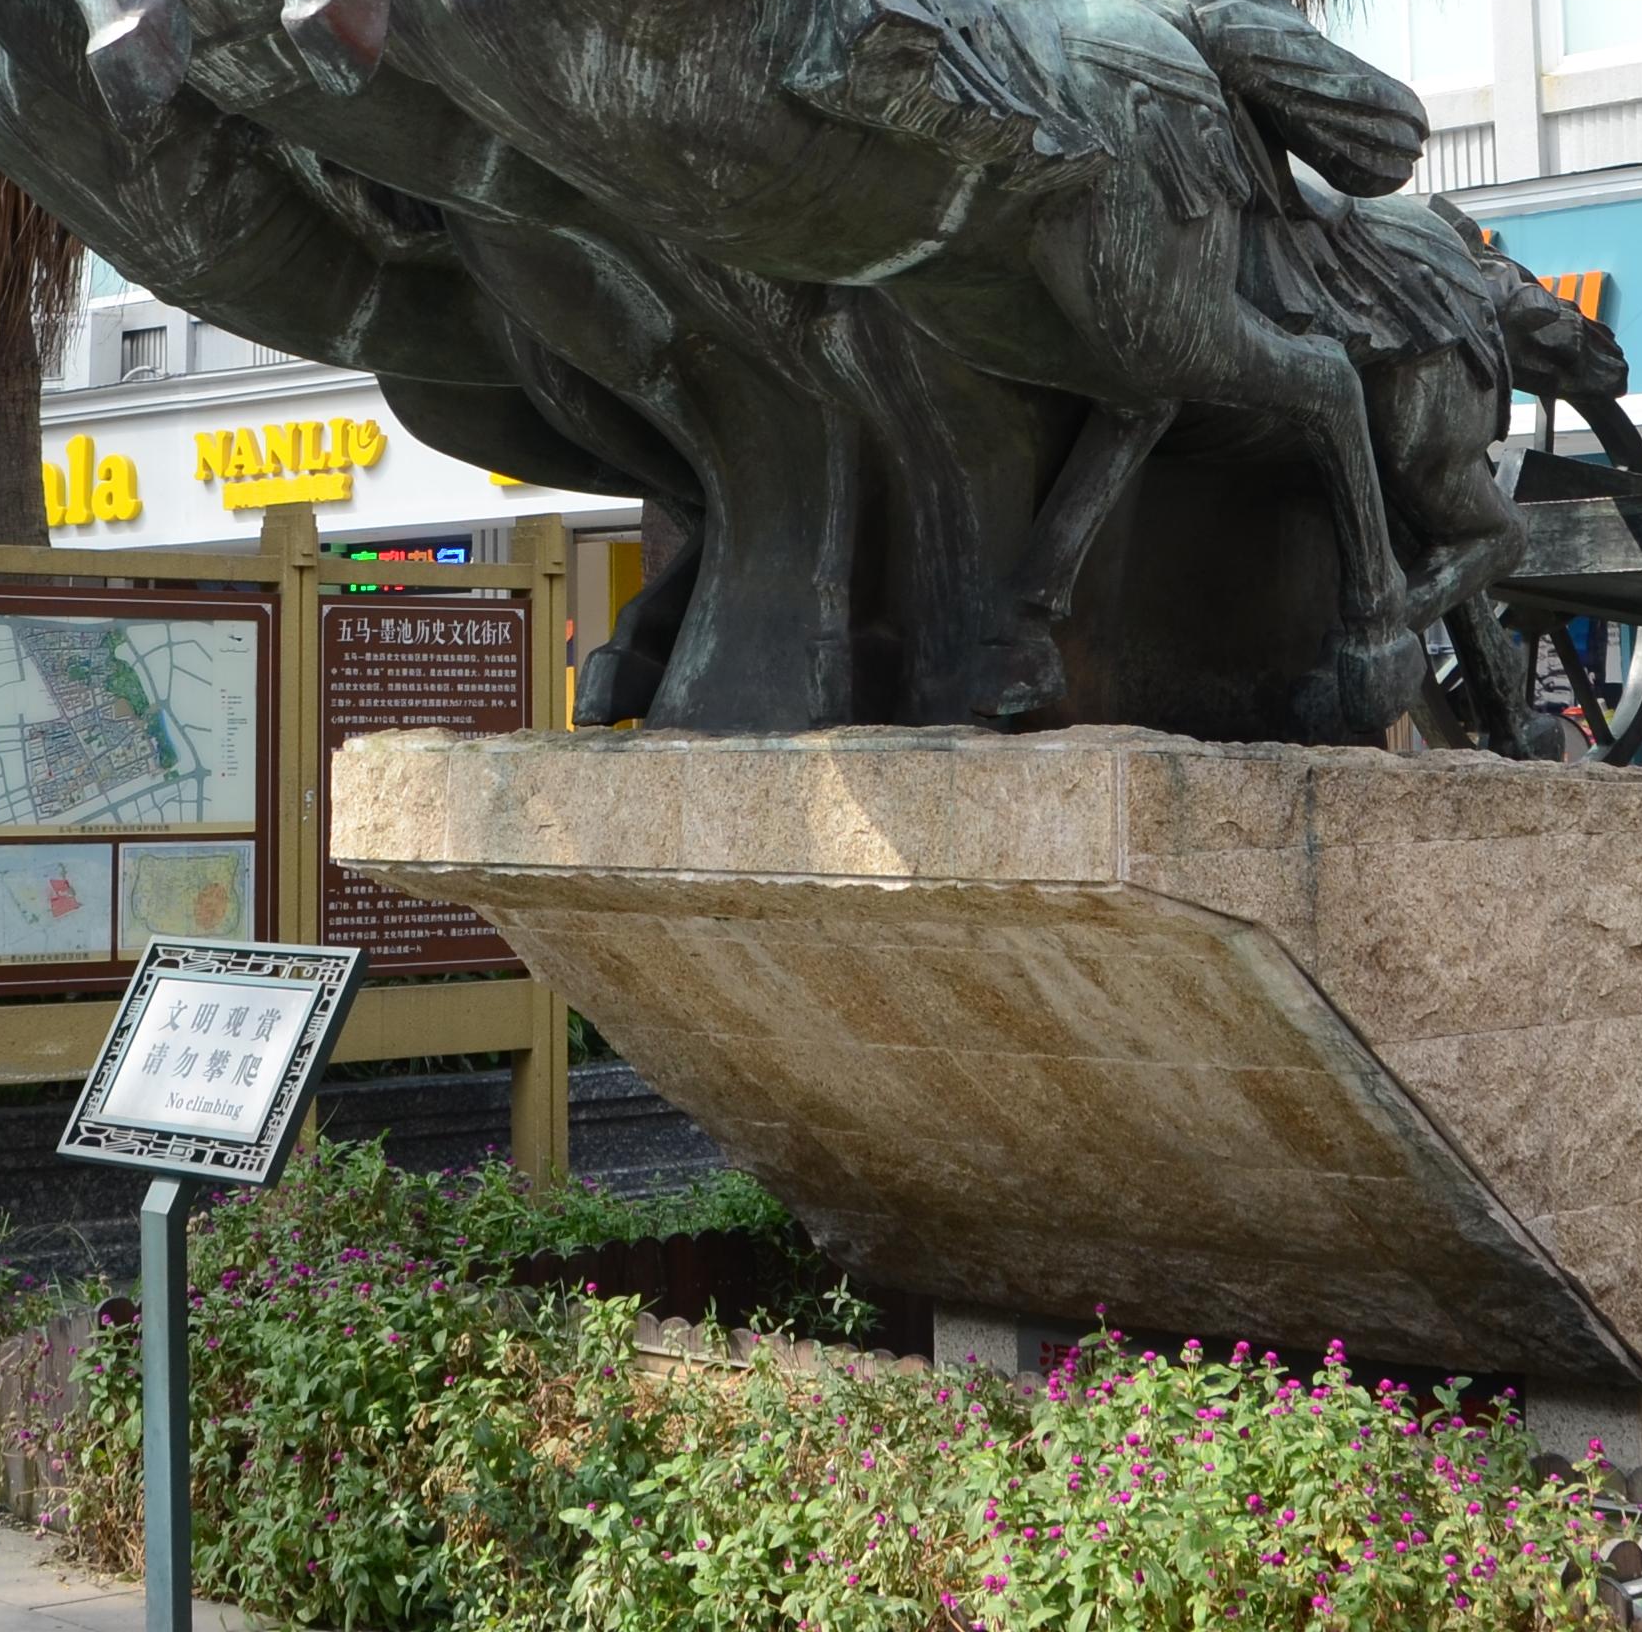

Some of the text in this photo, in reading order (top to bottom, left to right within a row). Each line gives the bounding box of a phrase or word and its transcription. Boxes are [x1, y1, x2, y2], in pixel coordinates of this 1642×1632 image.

[336, 618, 513, 646] 五马-墨池历史文化街区
[157, 999, 282, 1043] 文明观赏
[142, 1042, 264, 1088] 请勿攀爬
[165, 1091, 244, 1120] No climbing
